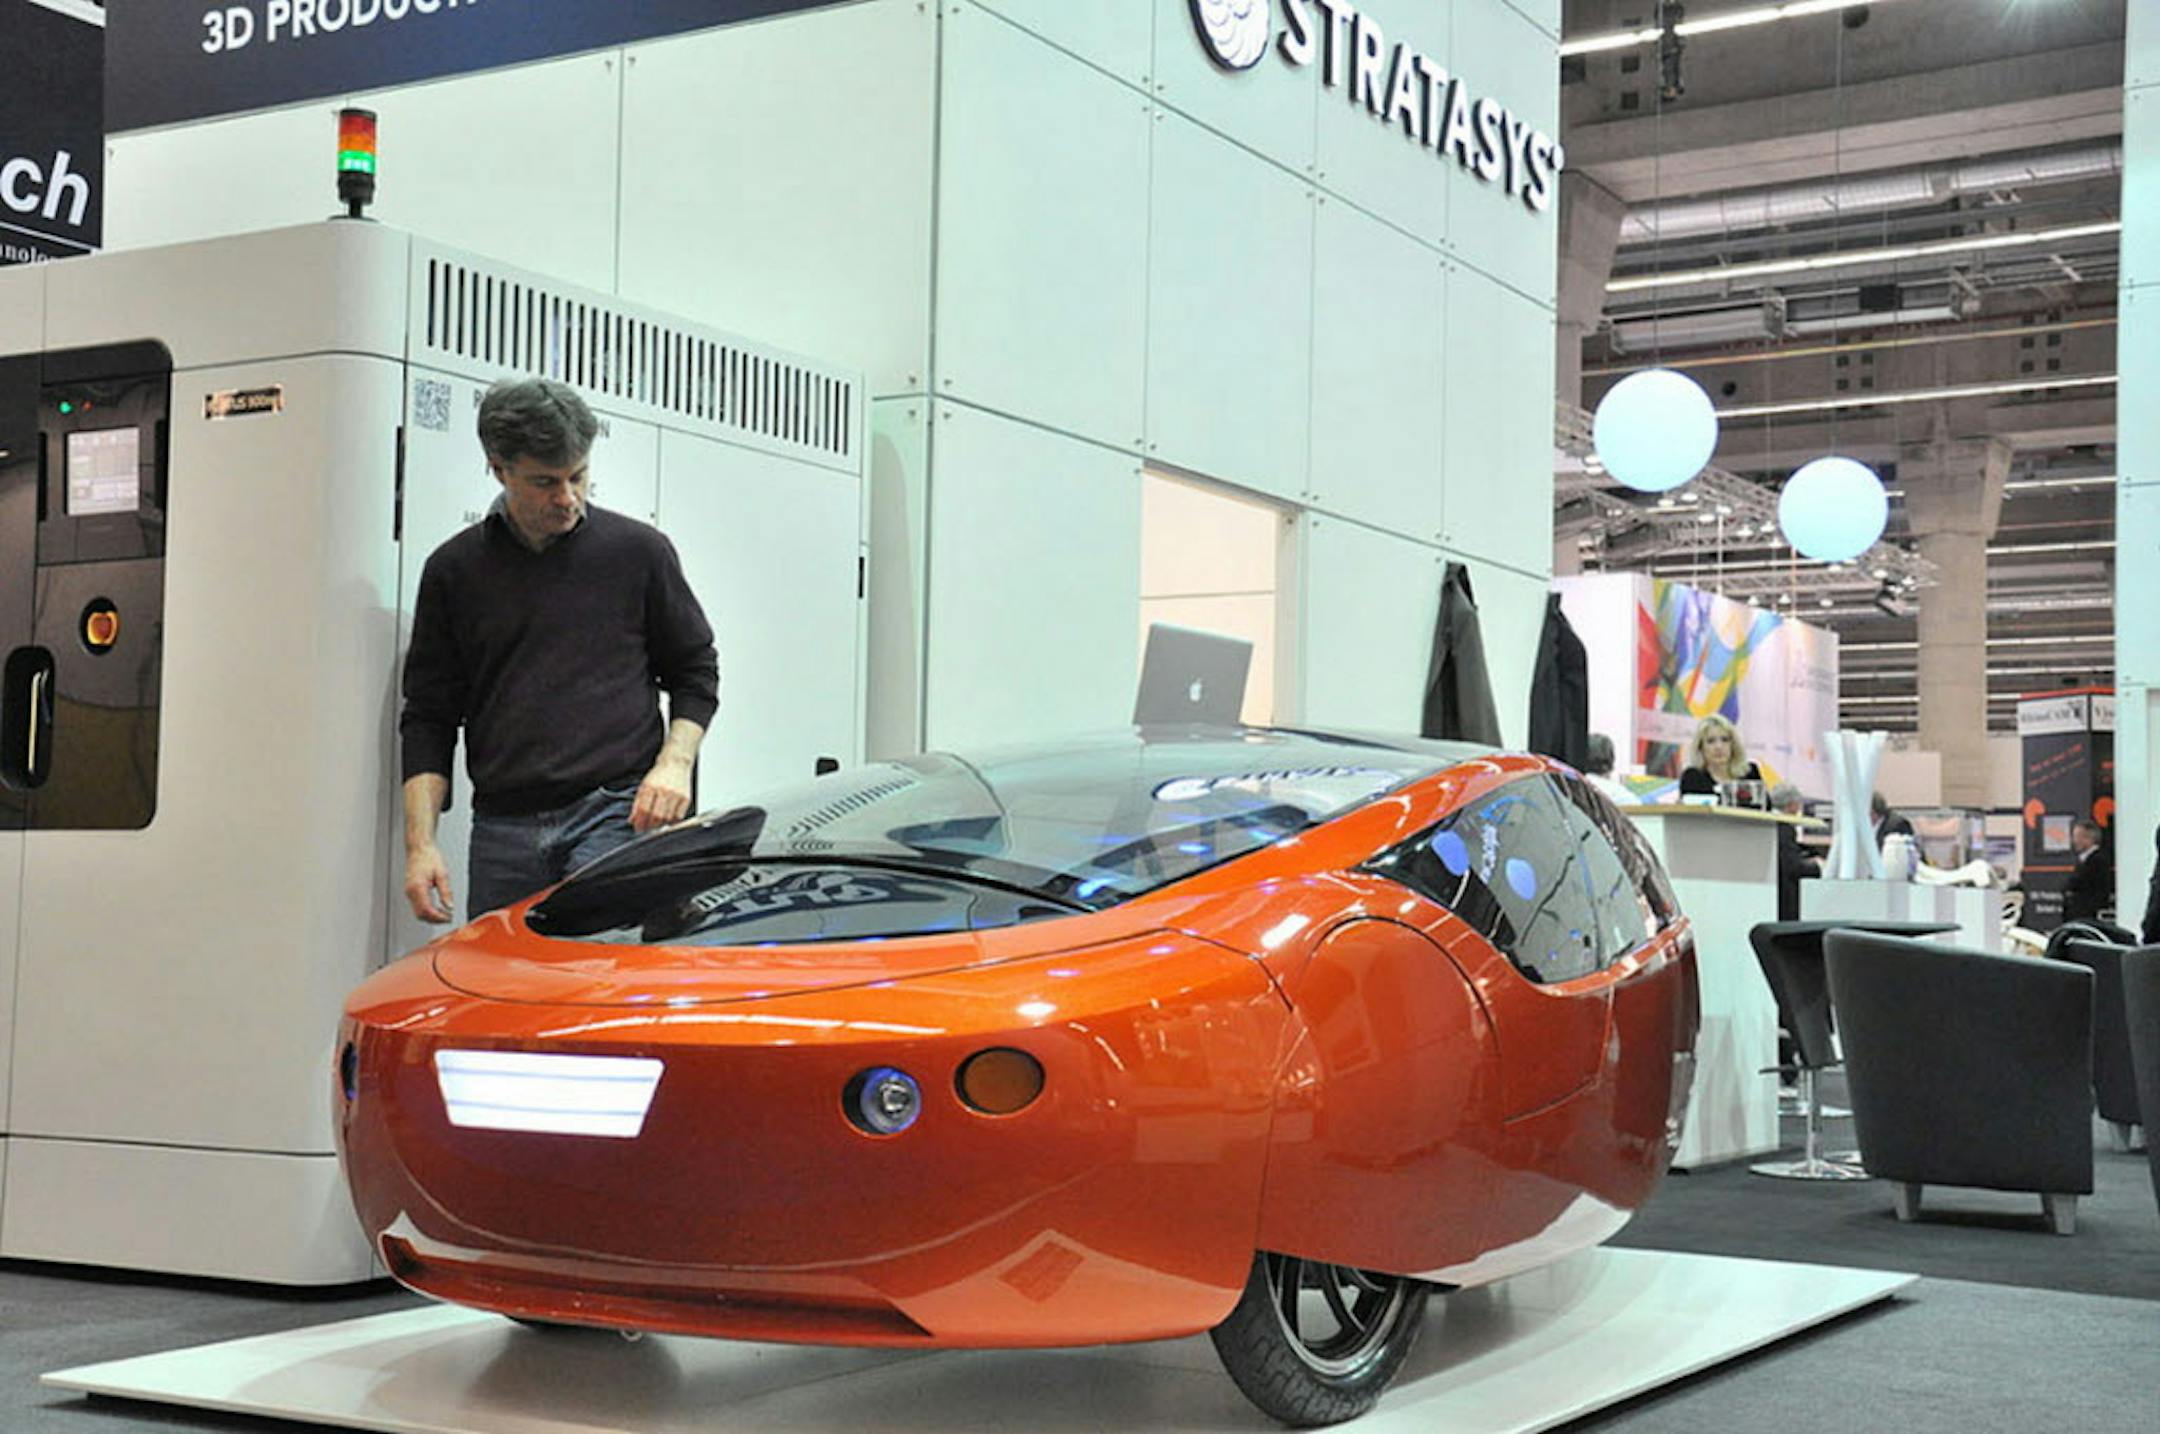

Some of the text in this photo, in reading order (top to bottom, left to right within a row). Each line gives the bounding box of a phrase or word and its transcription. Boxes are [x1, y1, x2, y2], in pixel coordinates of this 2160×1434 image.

[202, 0, 478, 53] 3D PROD
[1277, 0, 1555, 212] STRATASYS
